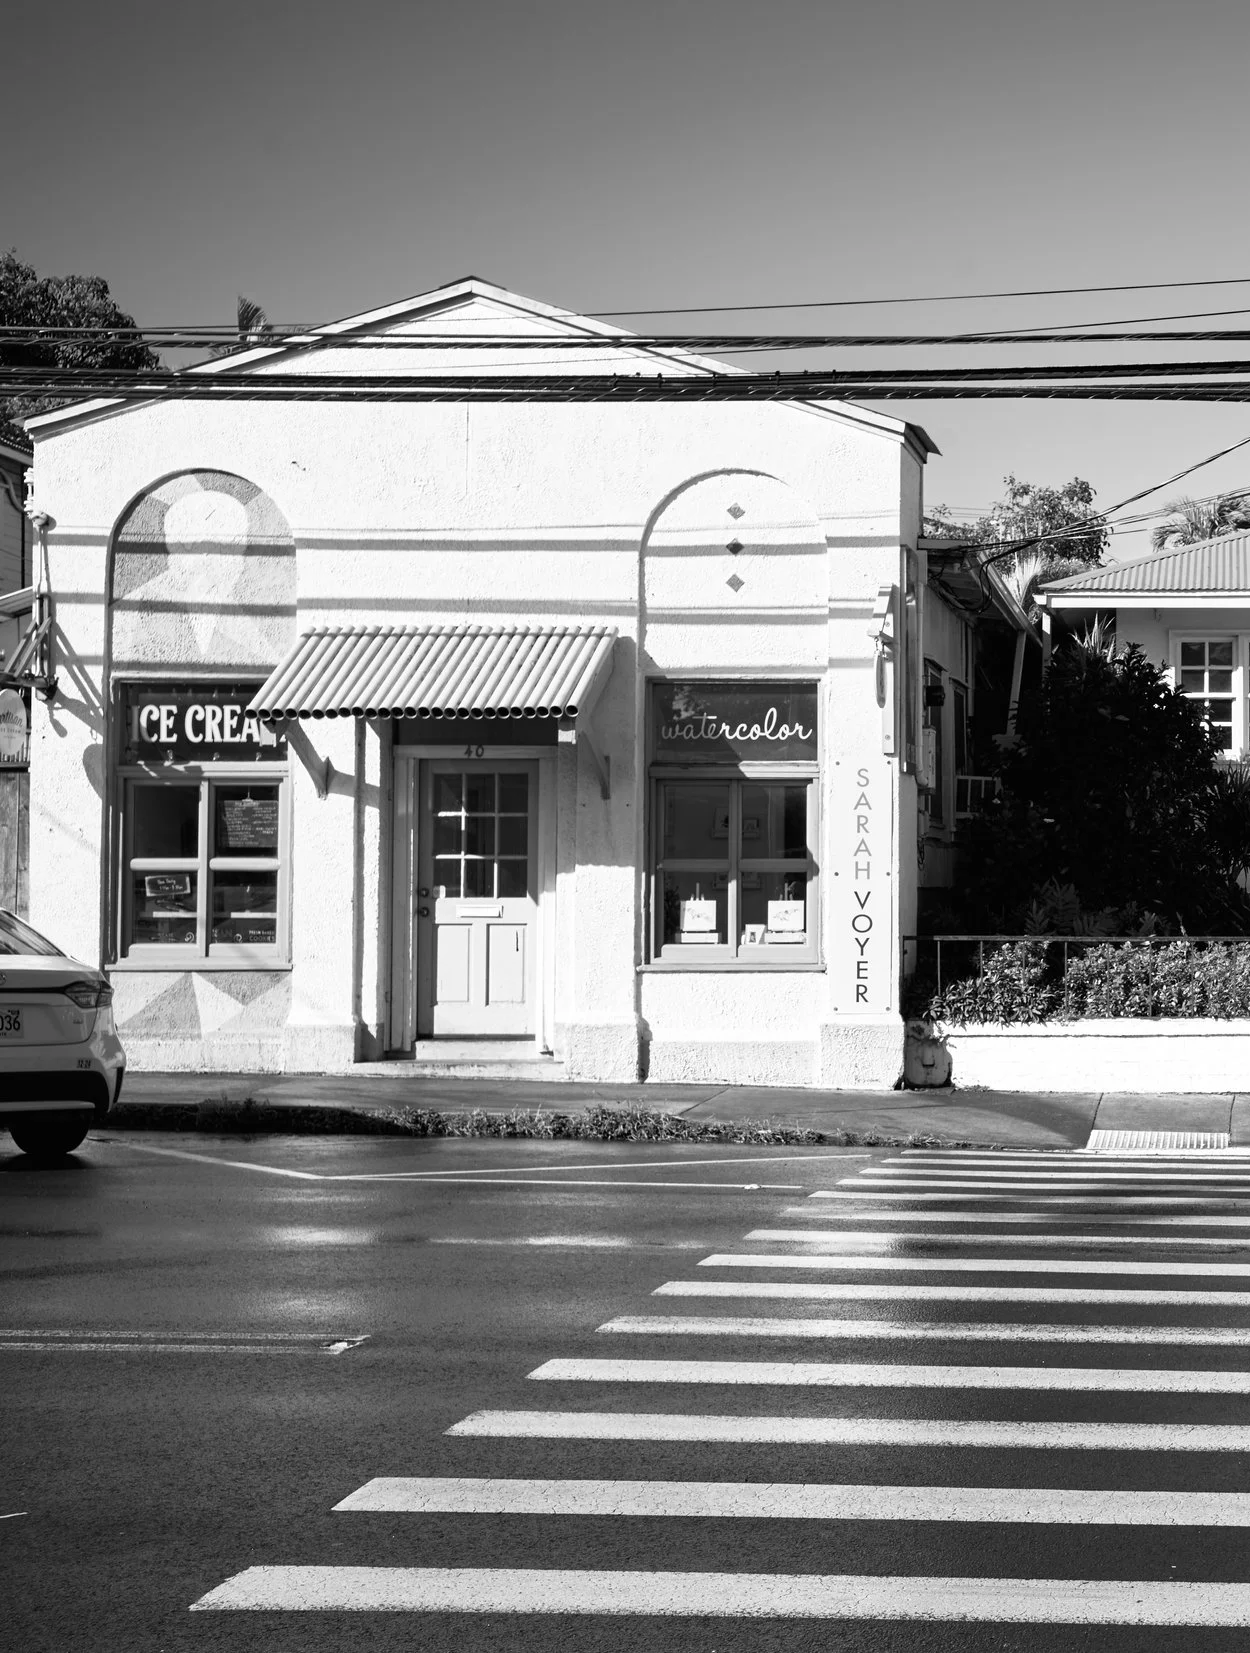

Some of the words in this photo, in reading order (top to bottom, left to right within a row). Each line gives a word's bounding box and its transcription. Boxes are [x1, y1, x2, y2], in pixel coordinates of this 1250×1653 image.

[131, 704, 178, 742] ICE
[184, 704, 286, 743] CREA
[661, 707, 813, 741] watercolor
[464, 745, 485, 758] 40
[853, 768, 872, 880] SARAH
[852, 891, 873, 1003] VOYER
